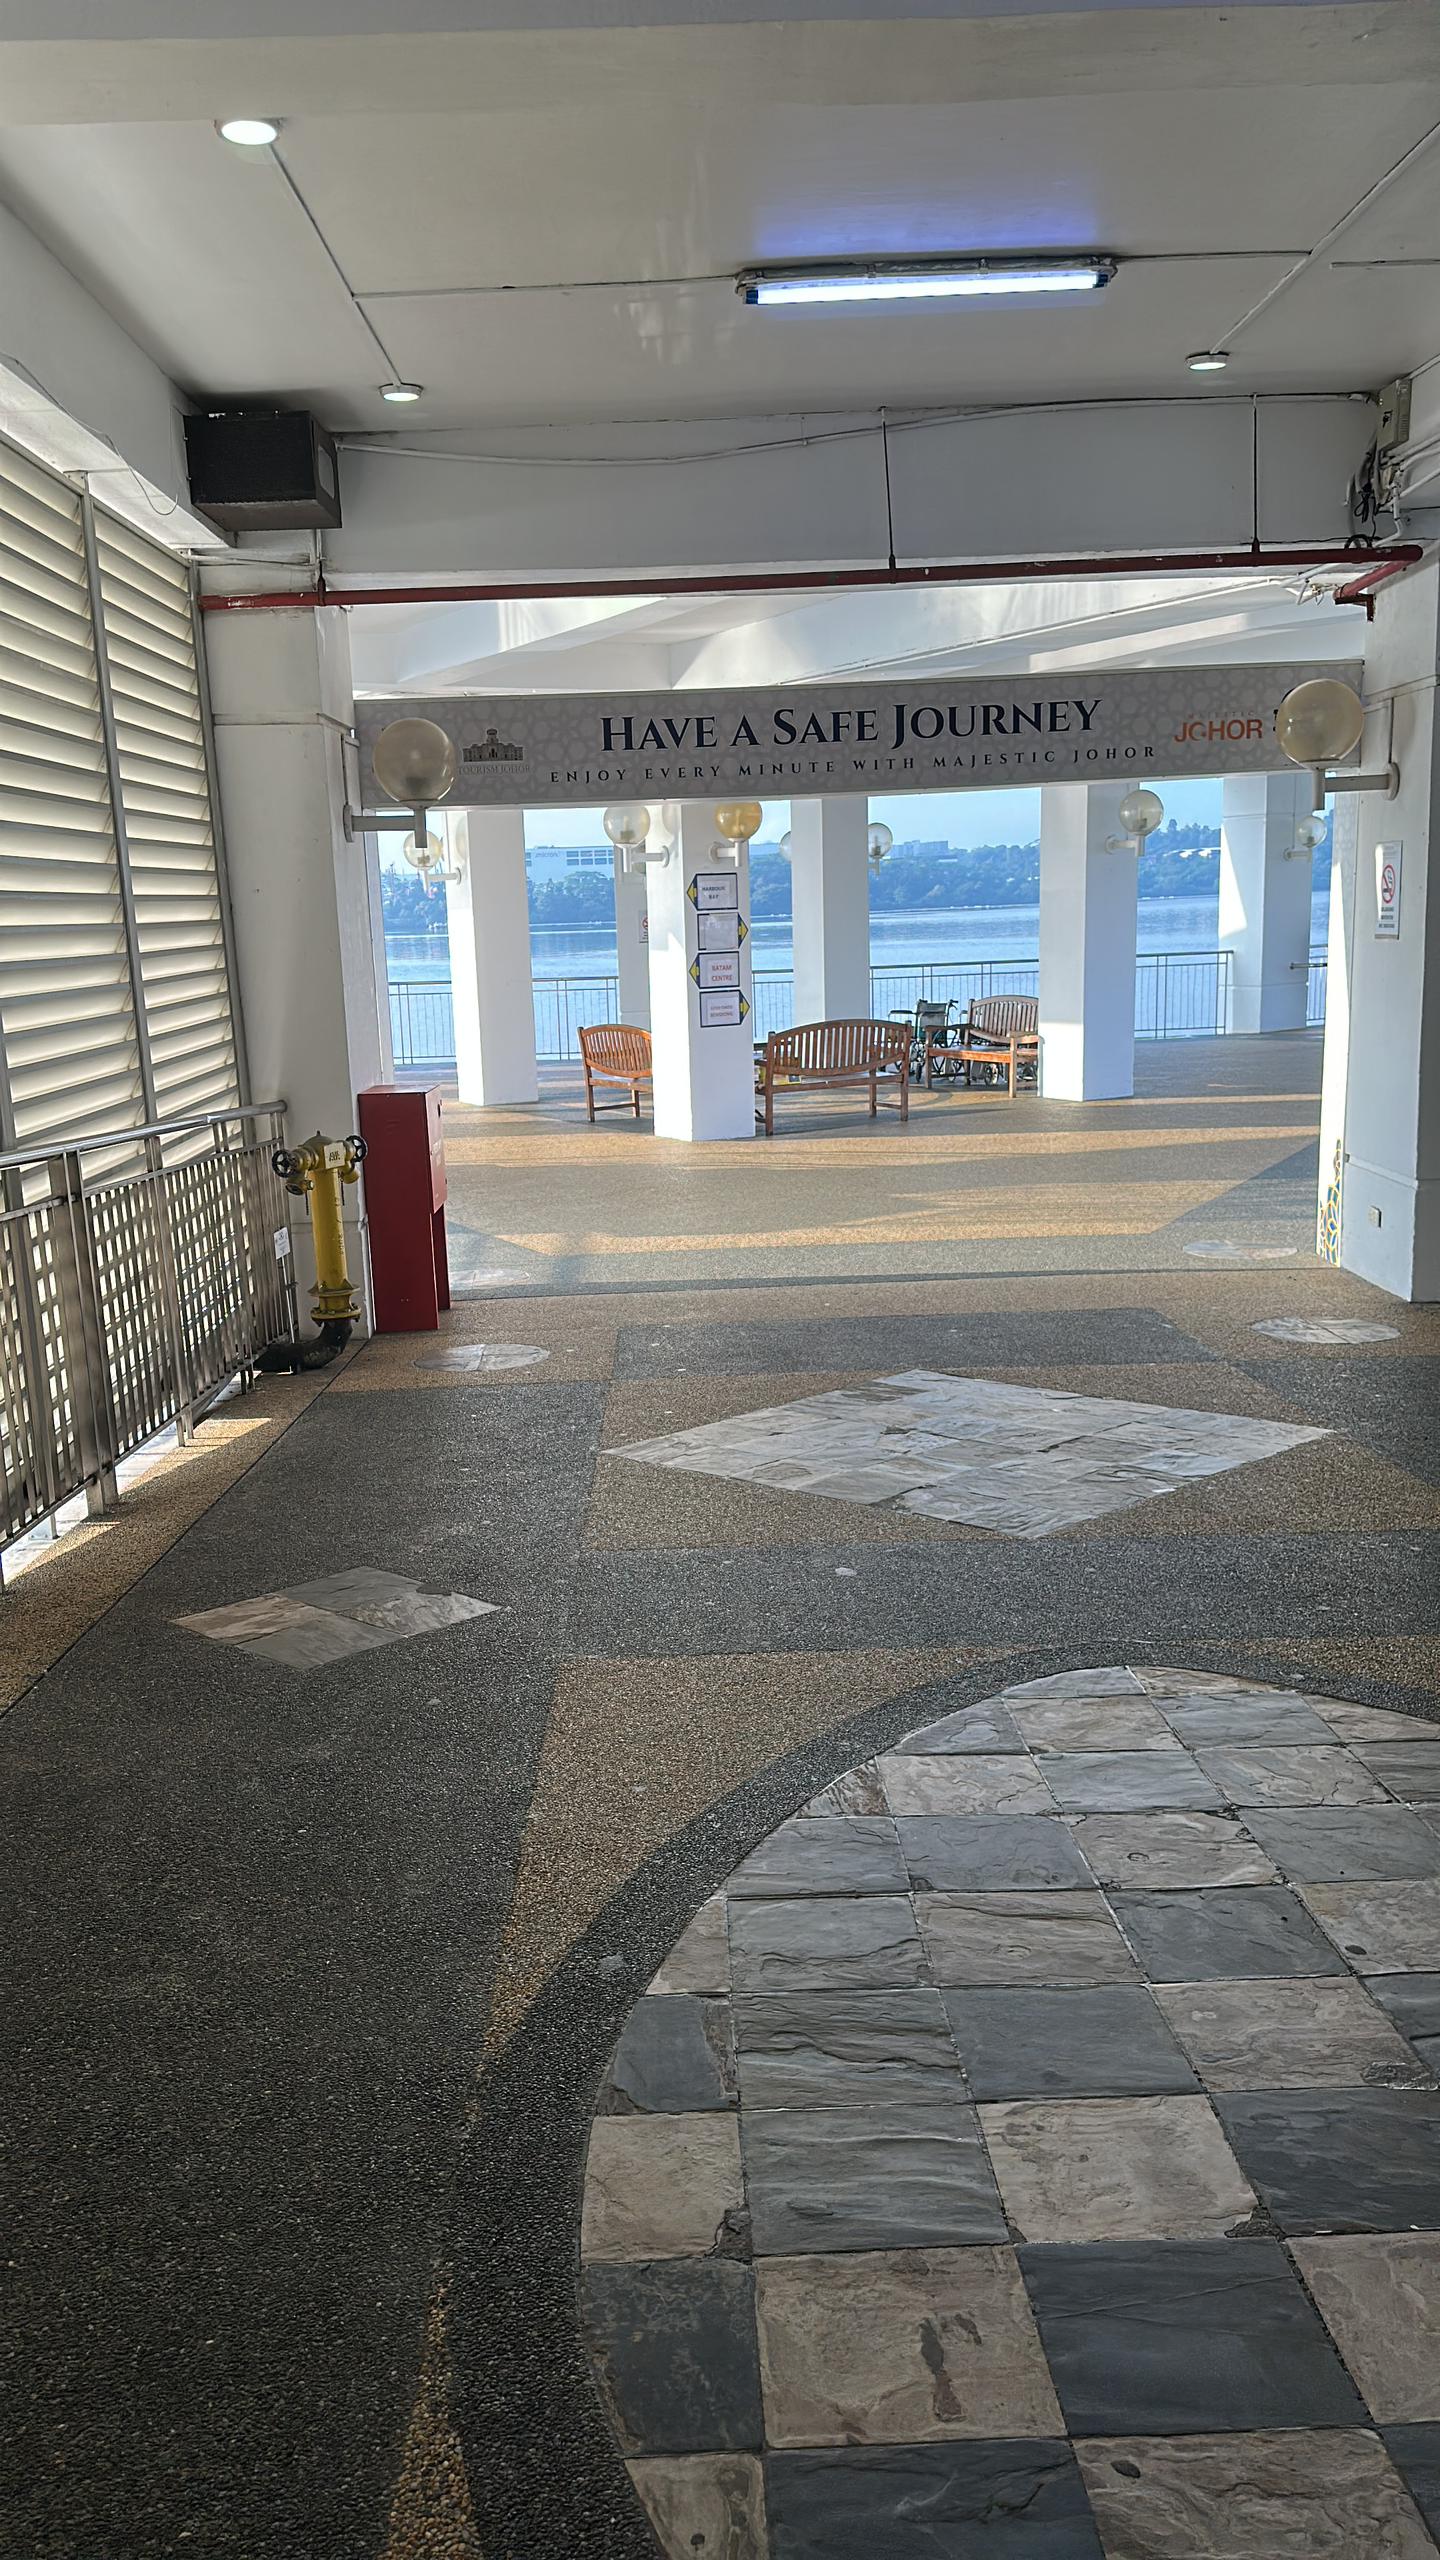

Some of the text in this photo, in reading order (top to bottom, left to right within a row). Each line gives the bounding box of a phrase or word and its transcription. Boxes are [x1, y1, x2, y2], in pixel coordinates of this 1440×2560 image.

[601, 699, 1103, 751] HAVE A SAFE JOURNEY
[551, 746, 1155, 783] ENJOY EVERY MINUTE WITH MAJESTIC JOHOR
